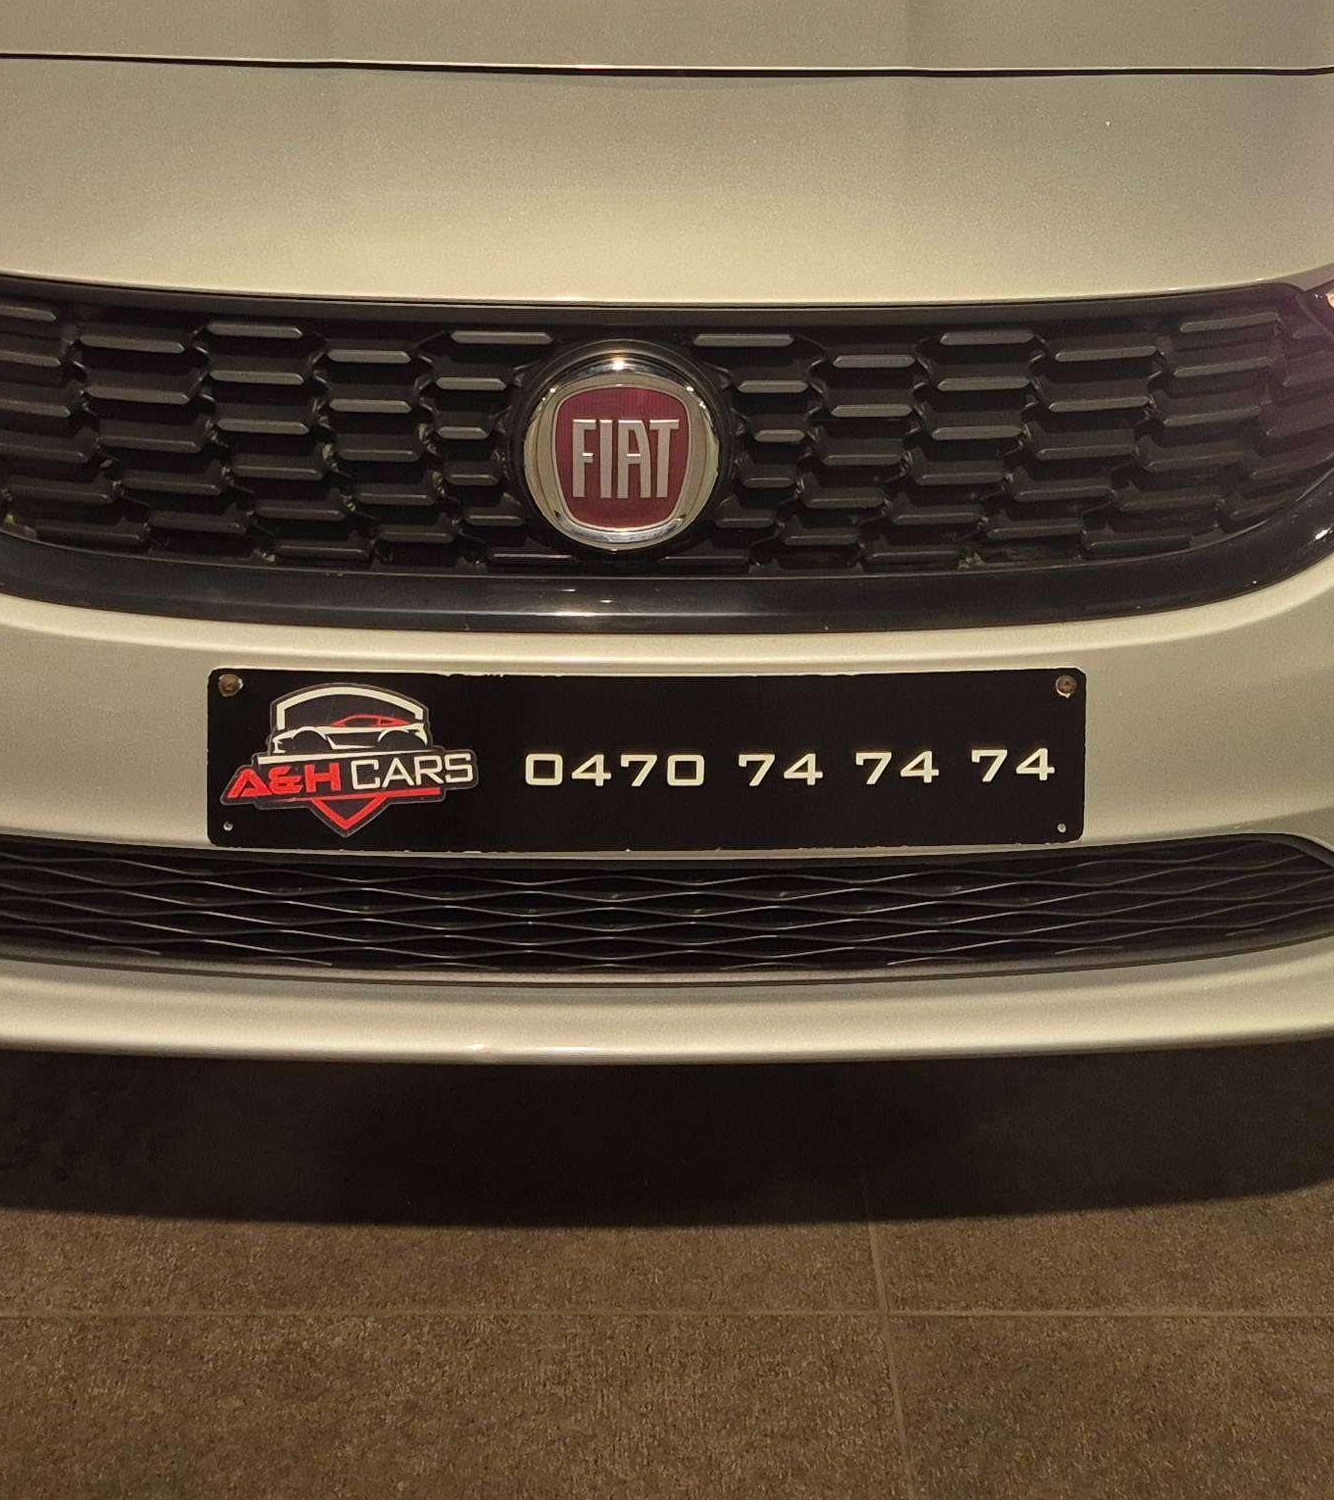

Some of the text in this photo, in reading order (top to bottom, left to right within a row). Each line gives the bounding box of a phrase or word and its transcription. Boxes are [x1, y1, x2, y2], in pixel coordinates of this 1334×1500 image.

[572, 419, 680, 499] FIAT
[226, 752, 474, 799] A&H CARS
[524, 747, 1056, 788] 0470 74 74 74
